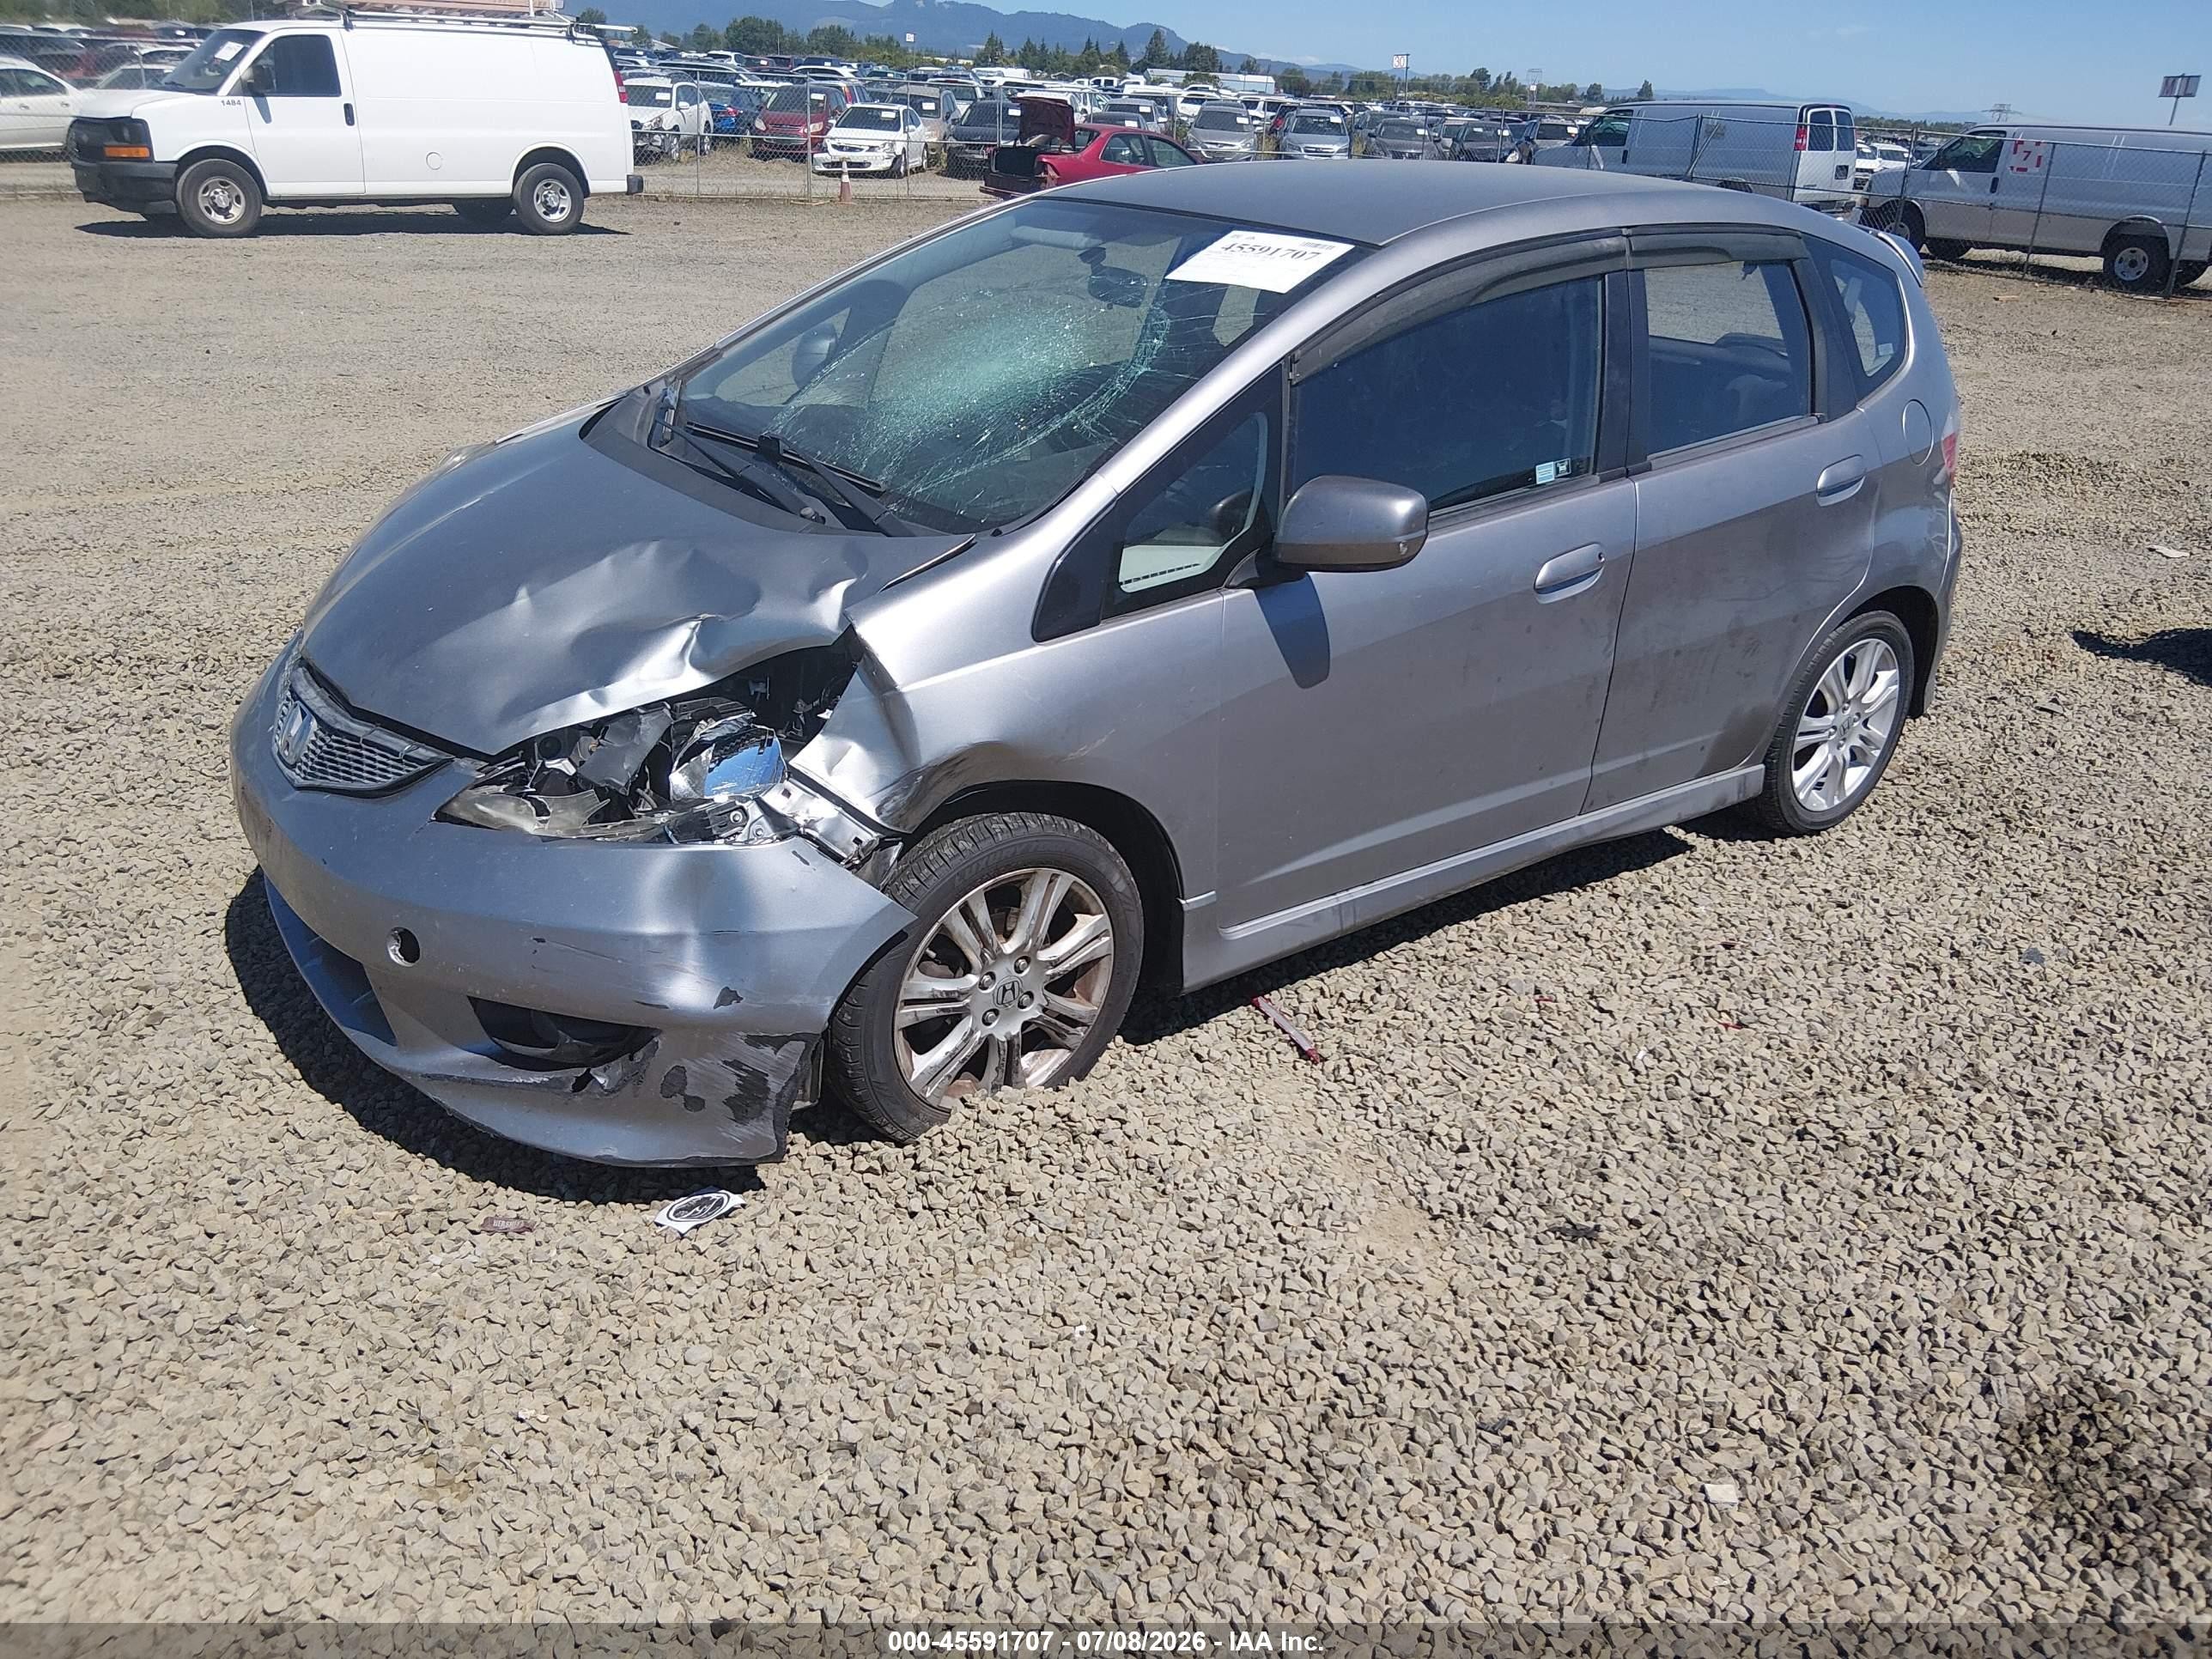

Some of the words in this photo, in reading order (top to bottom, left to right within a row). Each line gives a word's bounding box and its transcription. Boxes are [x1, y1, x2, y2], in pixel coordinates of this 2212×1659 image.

[1395, 56, 1405, 67] 30
[2023, 150, 2032, 161] 7
[1221, 242, 1322, 261] 45591707
